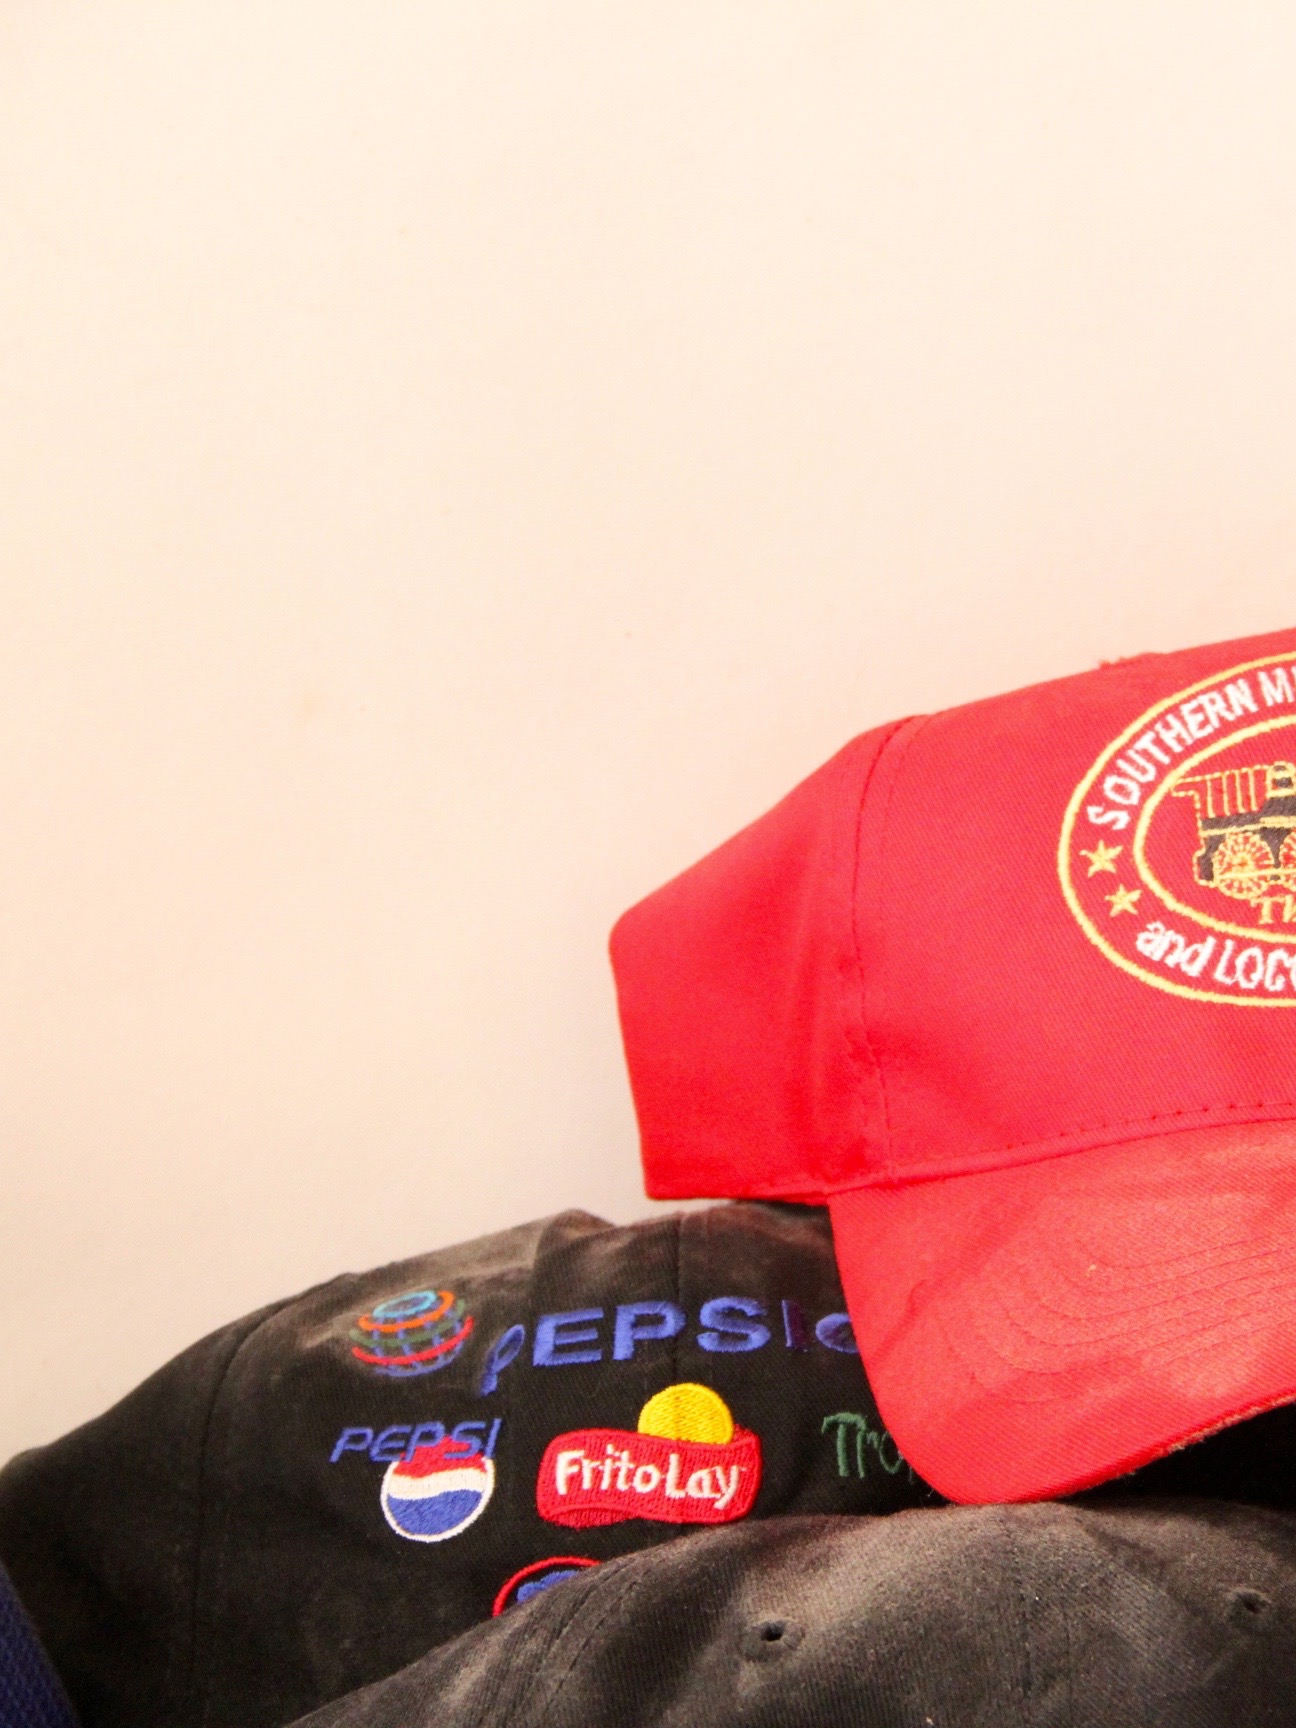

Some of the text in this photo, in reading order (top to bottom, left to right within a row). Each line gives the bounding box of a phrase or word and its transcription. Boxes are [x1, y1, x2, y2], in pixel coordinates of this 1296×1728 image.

[1088, 681, 1260, 830] SOUTHERN
[1135, 921, 1214, 979] and
[329, 1418, 502, 1463] PEPSI
